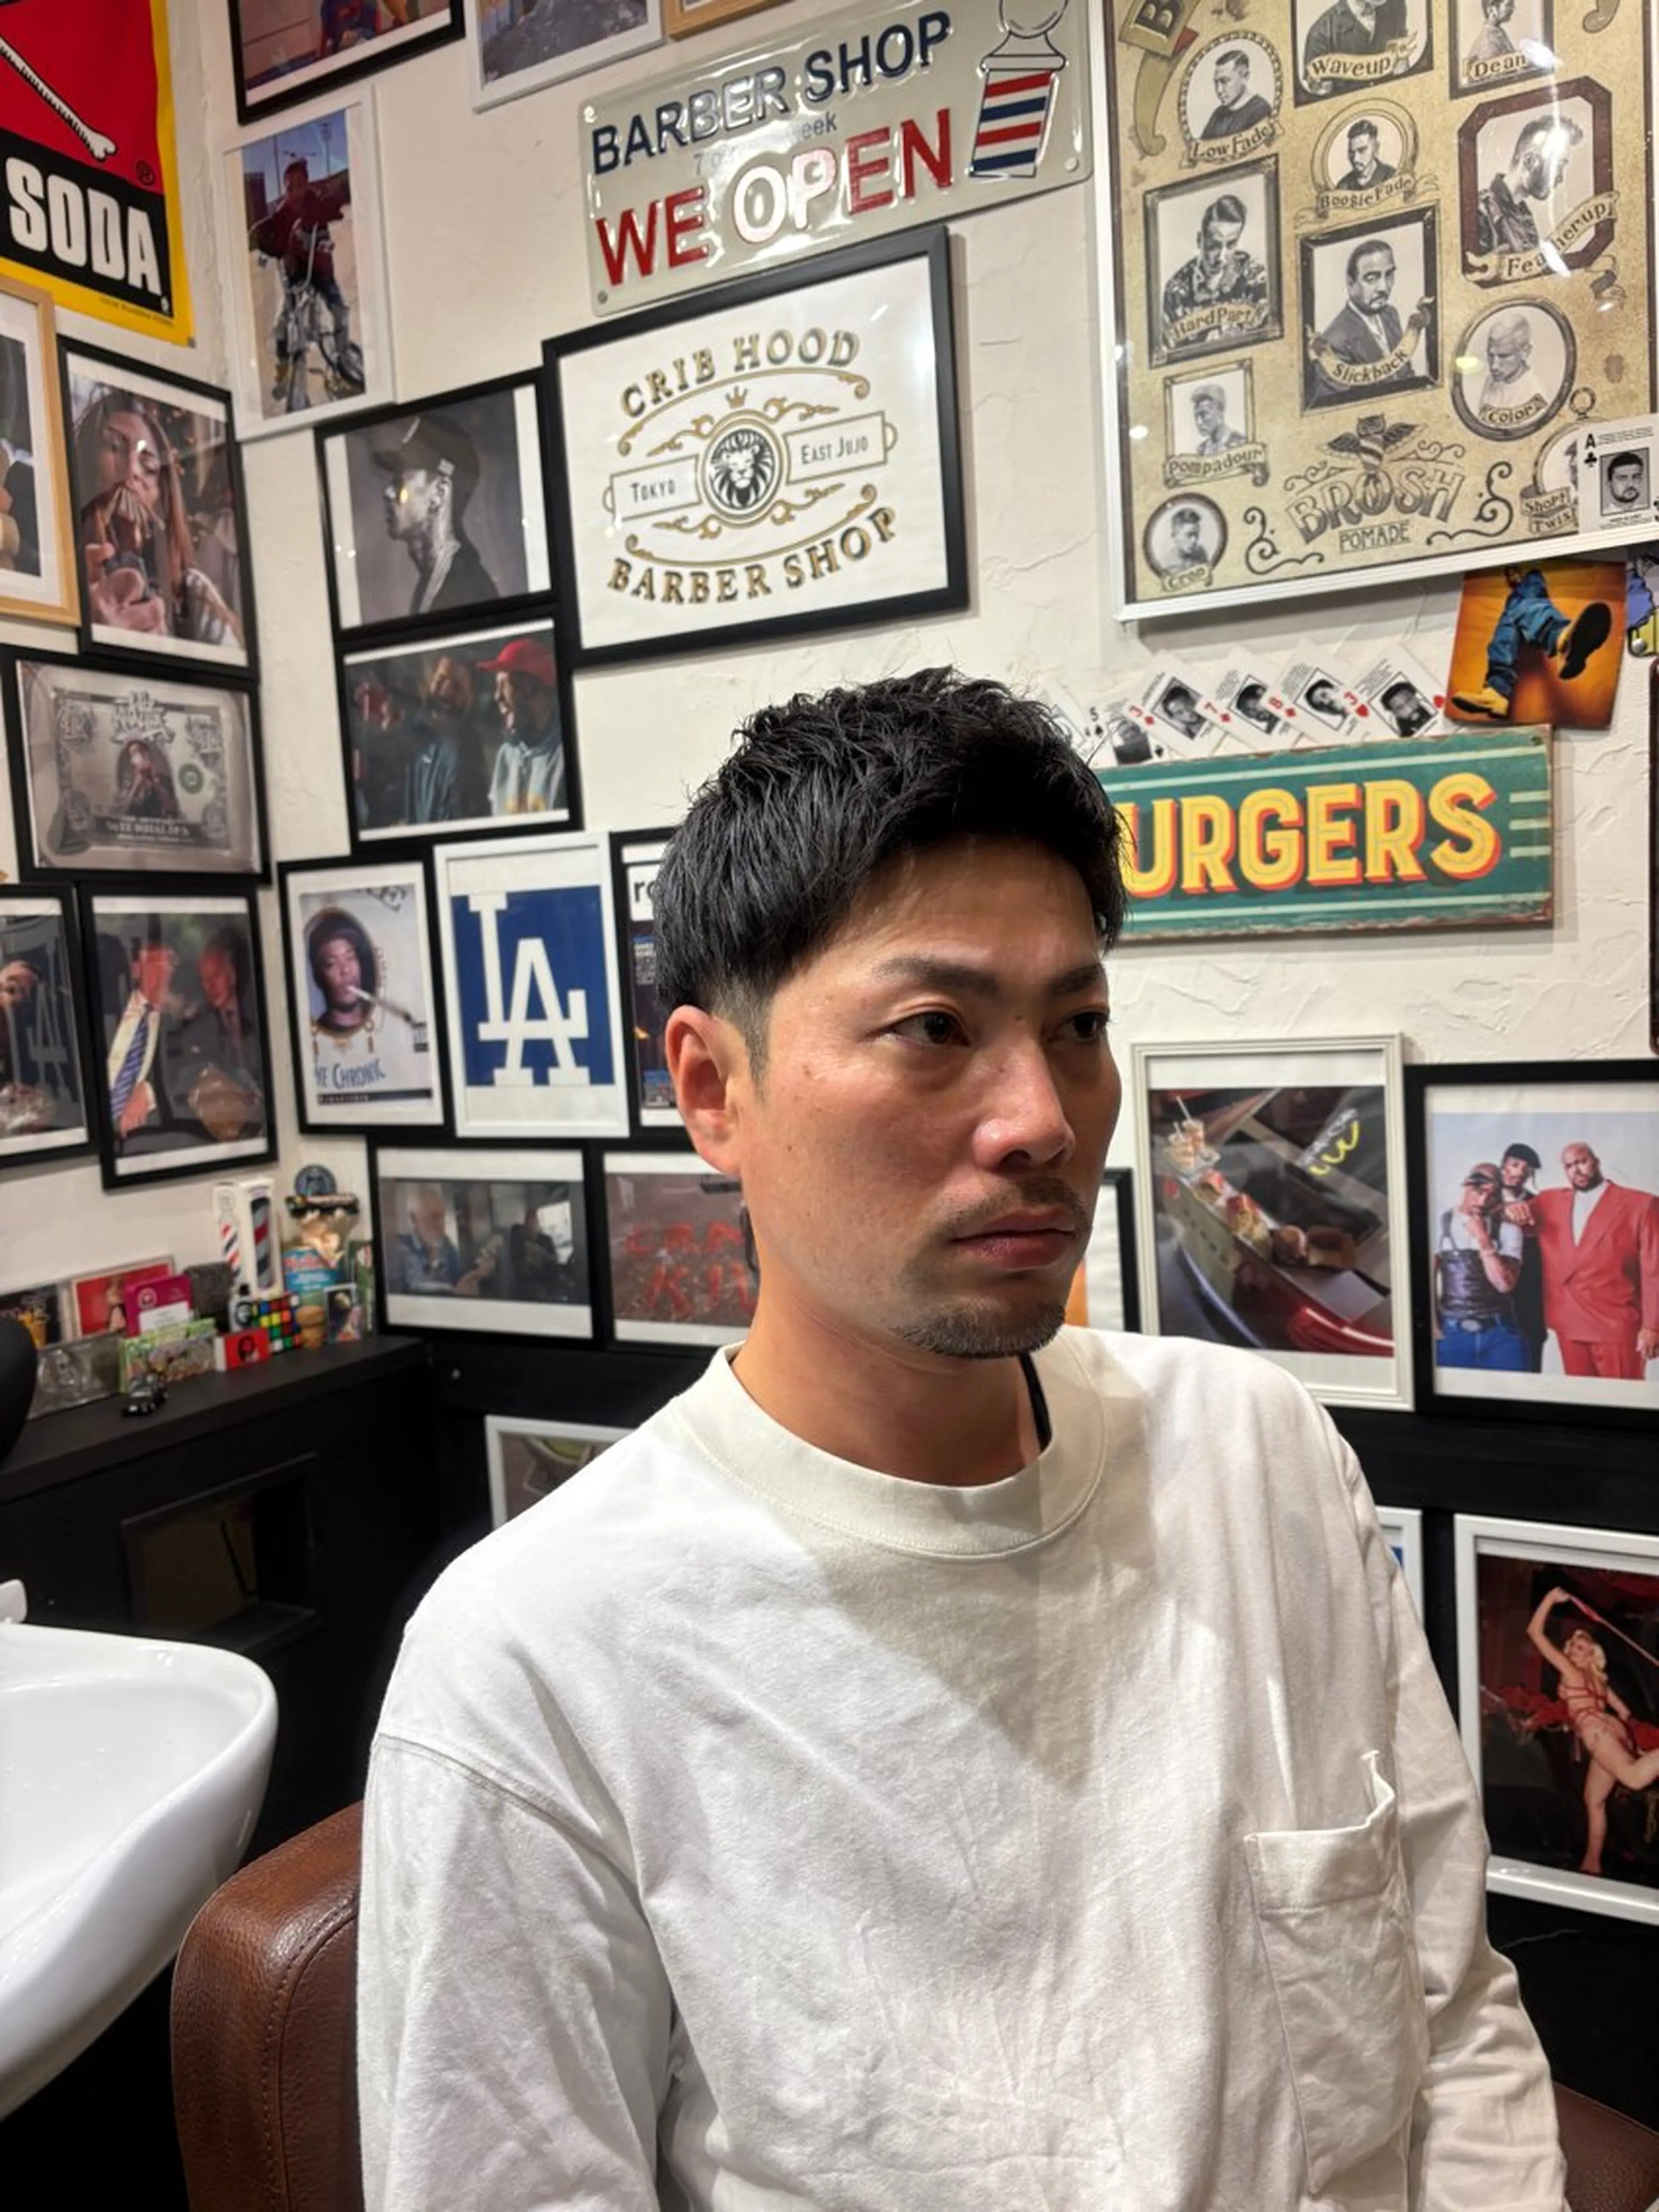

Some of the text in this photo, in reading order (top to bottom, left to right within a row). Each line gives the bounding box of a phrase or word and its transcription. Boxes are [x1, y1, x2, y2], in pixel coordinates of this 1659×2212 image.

[1311, 55, 1391, 76] Waveup
[1474, 54, 1526, 77] Dean
[591, 66, 788, 175] BARBER
[803, 11, 951, 103] SHOP
[1194, 126, 1269, 158] Low Fade
[596, 108, 952, 286] WE OPEN
[1321, 194, 1373, 208] Boogie
[5, 157, 162, 296] SODA
[1507, 203, 1606, 277] Feaherup
[621, 327, 861, 418] CRIB HOOD
[1169, 450, 1262, 475] Pompadour
[1585, 433, 1596, 450] A
[607, 508, 897, 604] BARBER SHOP
[1340, 520, 1410, 552] POMADE
[1118, 772, 1498, 900] URGERS
